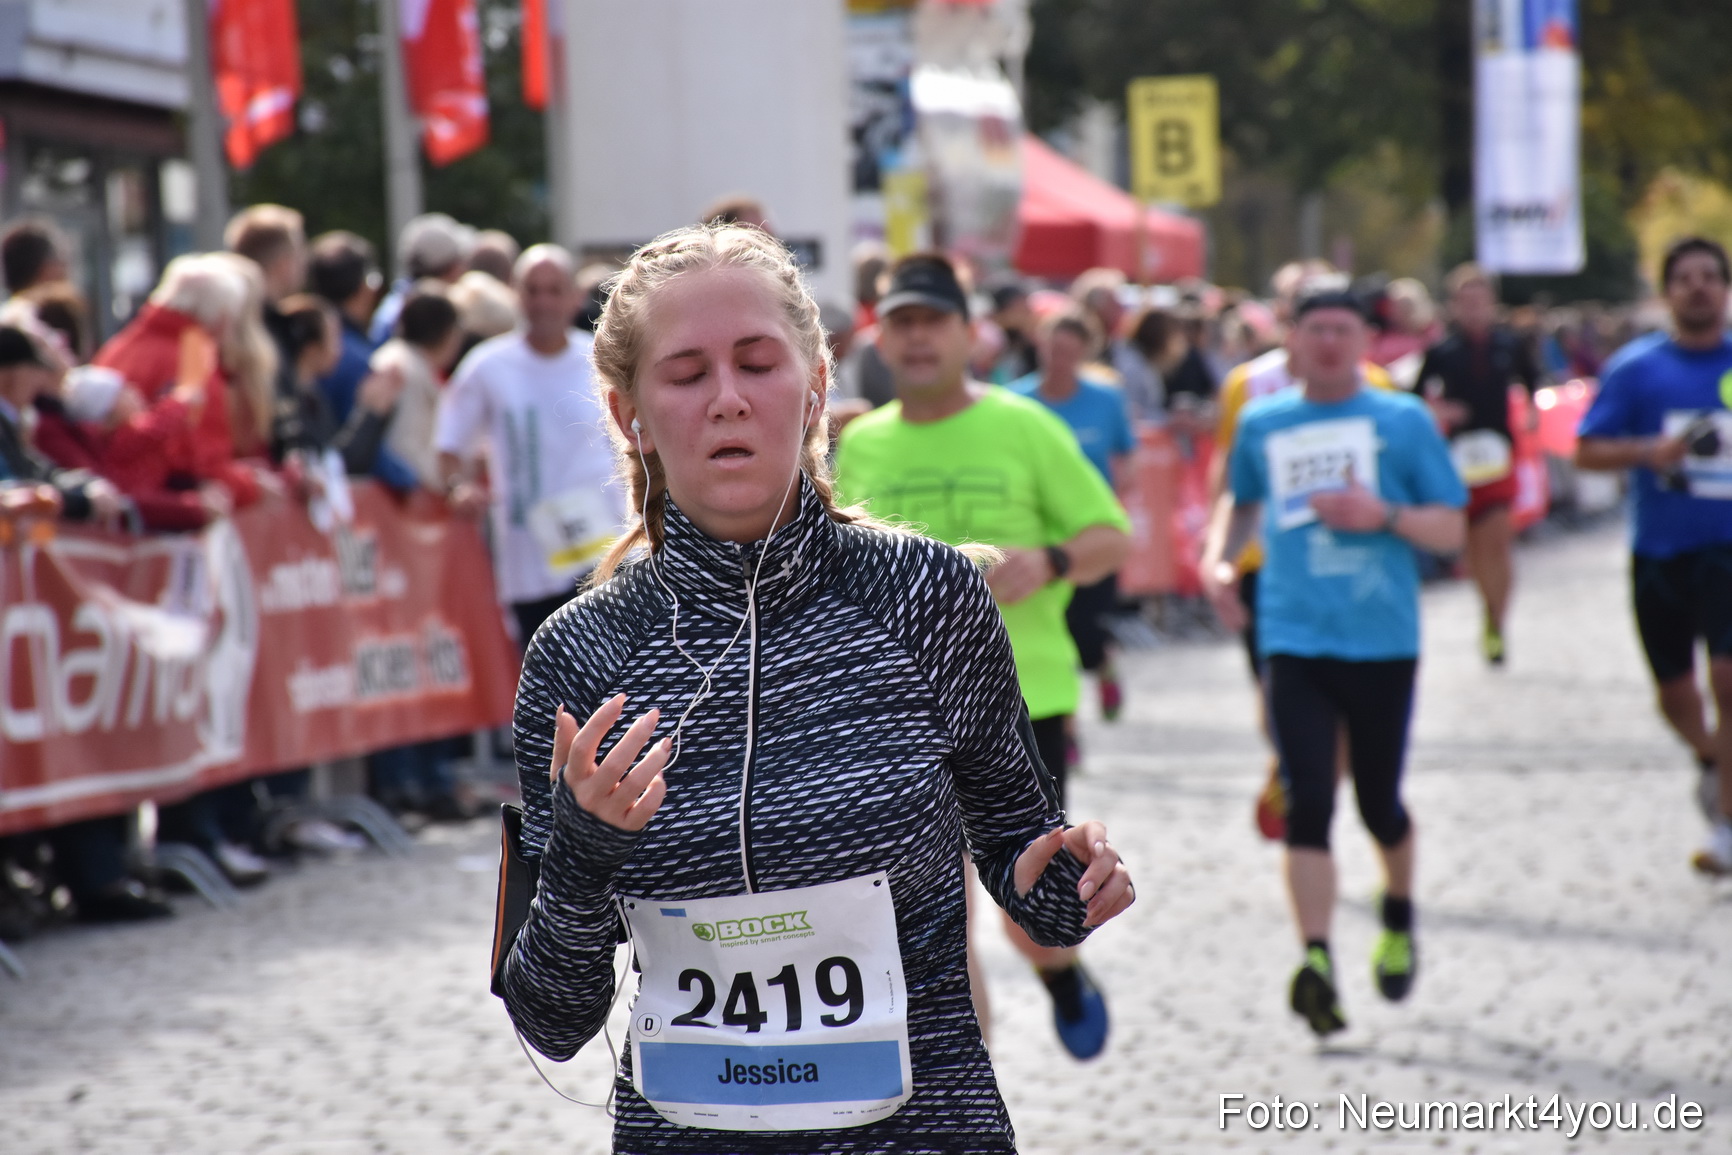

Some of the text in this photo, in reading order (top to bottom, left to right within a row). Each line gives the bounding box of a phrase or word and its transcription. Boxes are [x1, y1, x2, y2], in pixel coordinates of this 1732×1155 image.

[1154, 118, 1196, 177] B
[716, 910, 812, 941] BOCK
[719, 930, 816, 949] inspired by smart concepts
[670, 956, 864, 1034] 2419
[644, 1018, 654, 1031] D
[718, 1058, 819, 1085] Jessica
